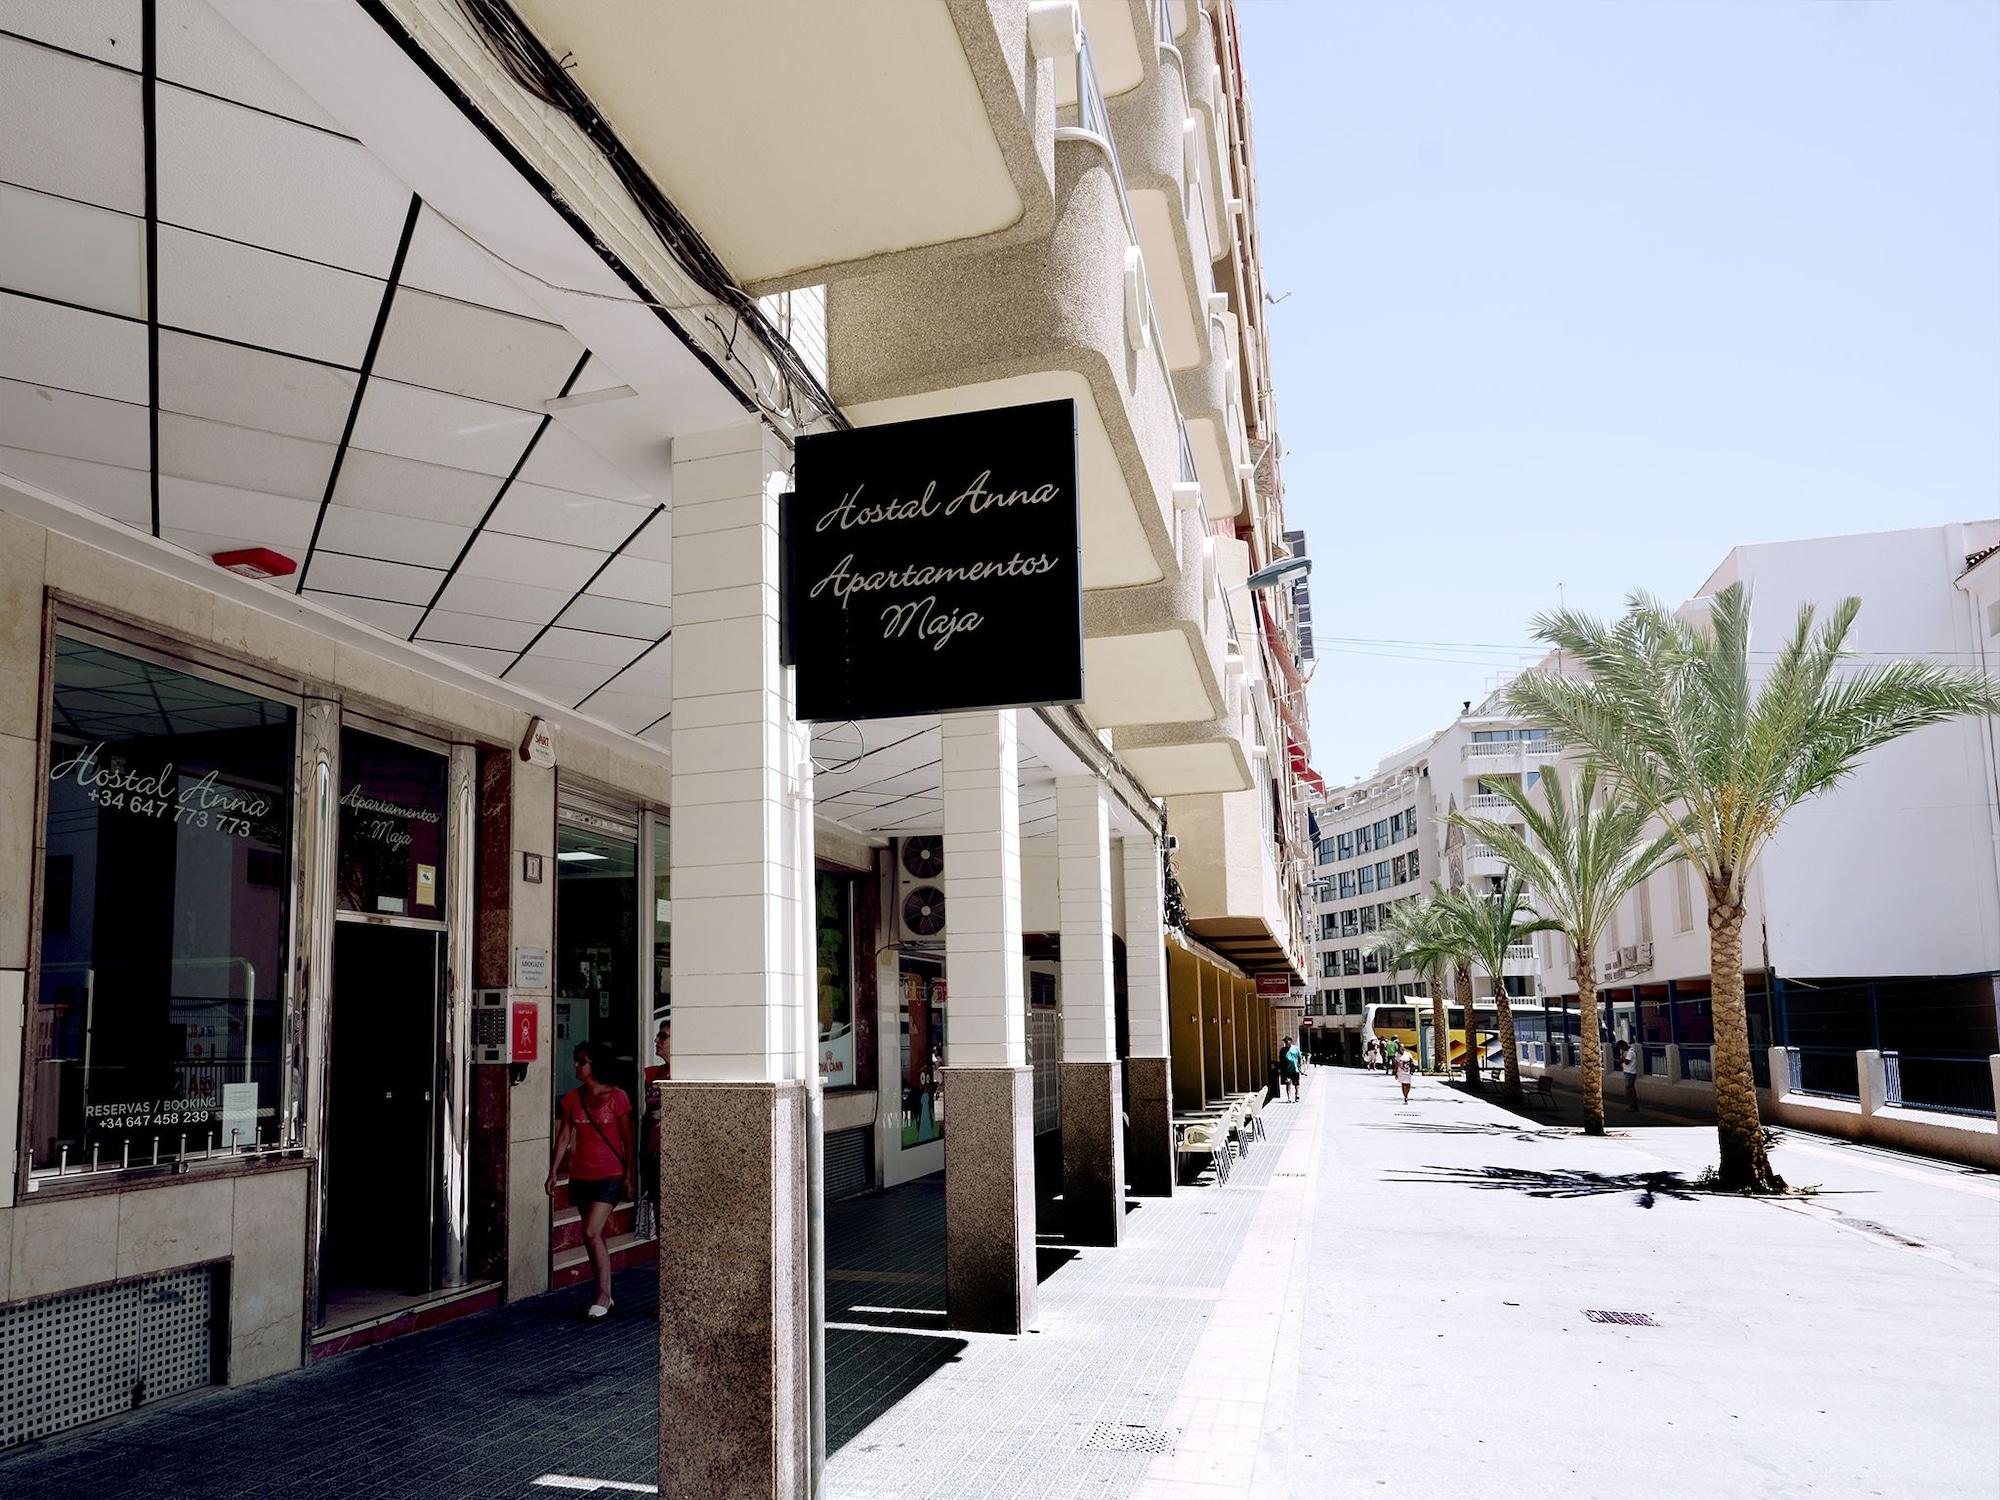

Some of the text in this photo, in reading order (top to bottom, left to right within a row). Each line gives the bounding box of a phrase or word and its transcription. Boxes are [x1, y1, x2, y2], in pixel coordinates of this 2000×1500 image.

[815, 469, 1060, 532] Hostal Anna
[810, 552, 1059, 609] Apartamentos
[880, 595, 985, 651] Maja
[50, 741, 270, 817] Hostal Anna
[88, 789, 251, 837] +34 647 773 773
[340, 784, 440, 823] Apartamentos
[371, 820, 413, 851] Maja
[85, 1102, 150, 1117] RESERVAS
[163, 1097, 217, 1112] BOOKING
[99, 1111, 209, 1129] +34 647 458 239
